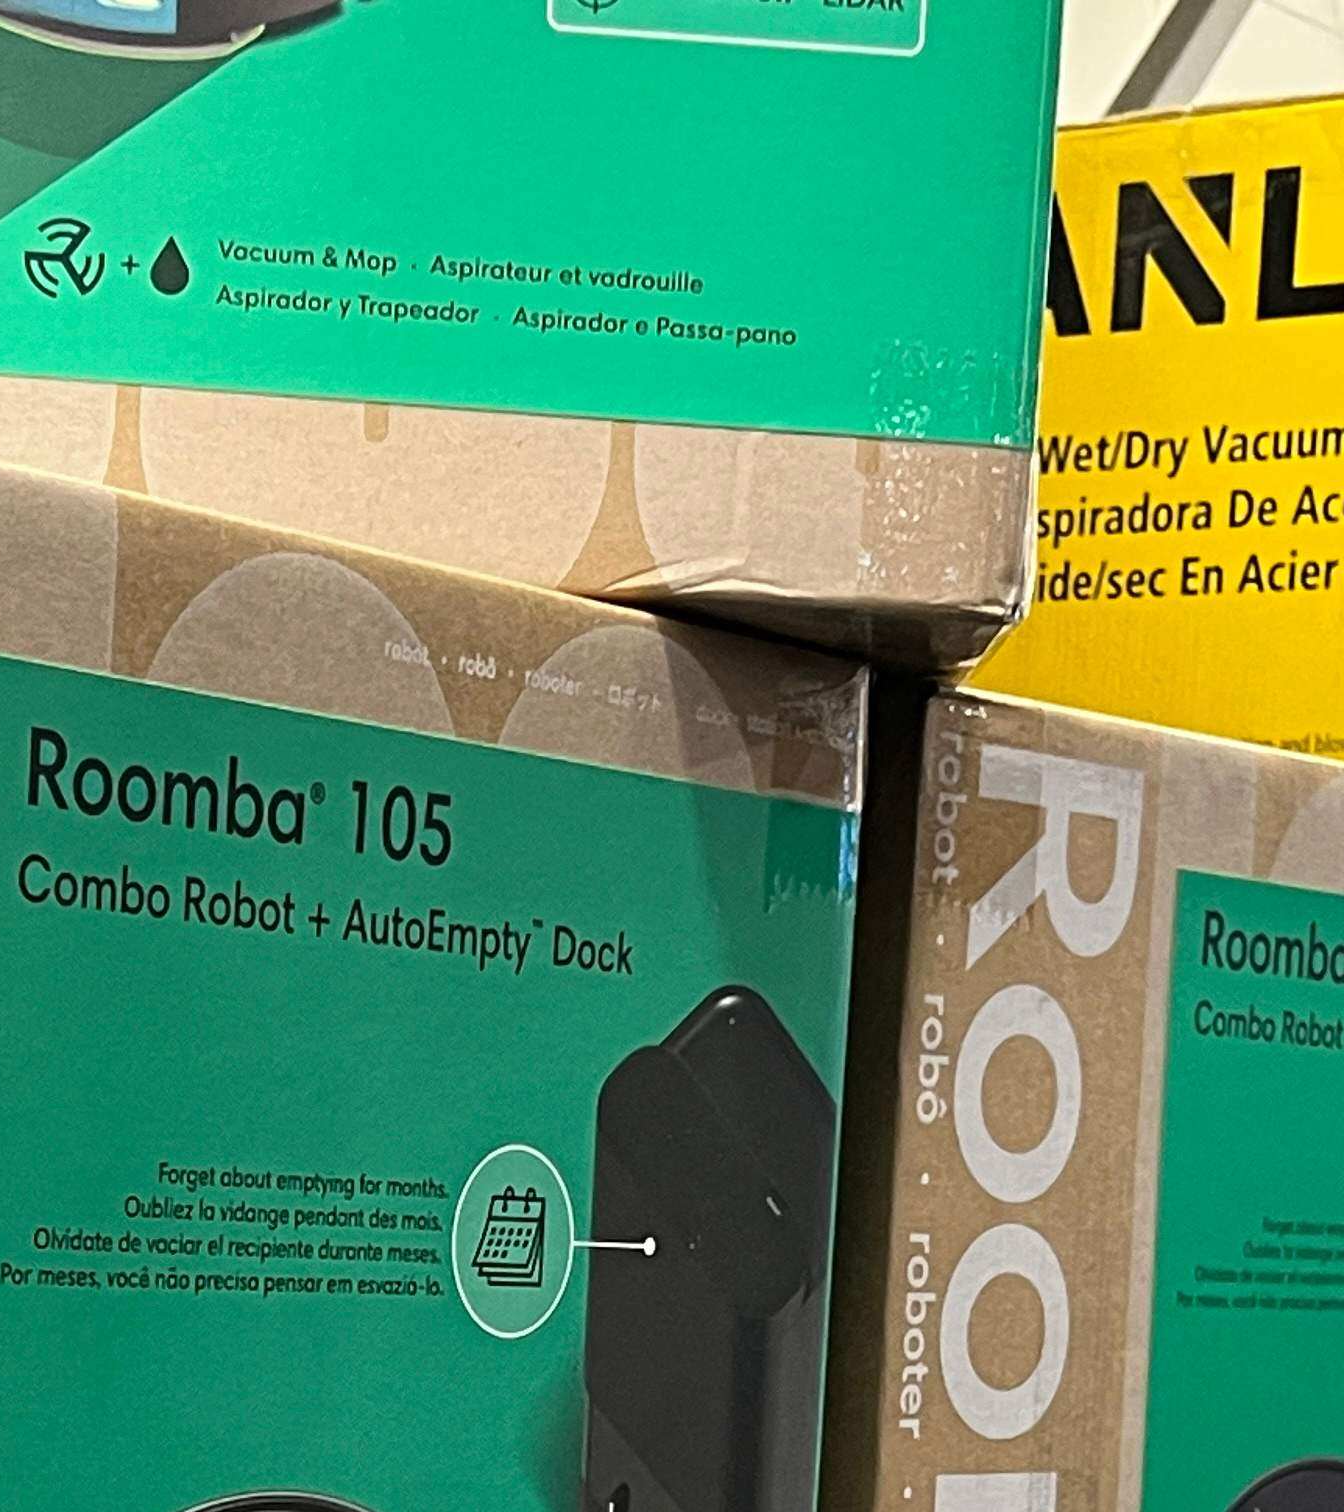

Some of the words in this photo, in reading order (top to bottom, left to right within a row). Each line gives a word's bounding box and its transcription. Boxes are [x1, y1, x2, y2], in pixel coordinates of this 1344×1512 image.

[218, 239, 315, 266] Vacuum
[322, 246, 338, 268] &
[345, 248, 397, 277] Mop
[429, 255, 552, 283] Aspirateur
[559, 266, 582, 286] et
[589, 268, 704, 295] vadrouille
[216, 284, 333, 313] Aspirador
[339, 299, 352, 320] y
[358, 294, 479, 323] Trapeador
[512, 306, 629, 334] Aspirador
[635, 319, 649, 336] e
[657, 316, 797, 348] Passa-pano
[1038, 428, 1188, 478] Wet/Dry
[1037, 489, 1213, 548] spiradora
[1229, 487, 1276, 528] De
[1037, 560, 1165, 602] ide/sec
[1181, 556, 1224, 597] En
[1238, 548, 1338, 592] Acier
[349, 780, 454, 867] 105
[17, 853, 172, 920] Combo
[183, 874, 296, 937] Robot
[552, 923, 635, 977] Dock
[1194, 1000, 1276, 1043] Combo
[1281, 1009, 1344, 1051] Robot
[916, 993, 949, 1125] robô
[159, 1162, 216, 1193] Forget
[220, 1166, 273, 1189] about
[276, 1172, 356, 1201] emptying
[359, 1172, 383, 1196] for
[386, 1176, 451, 1200] months.
[124, 1195, 194, 1221] Oubliez
[199, 1198, 216, 1222] la
[219, 1200, 291, 1232] vidange
[294, 1205, 365, 1231] pendant
[368, 1207, 398, 1230] des
[118, 1230, 143, 1254] de
[147, 1233, 204, 1256] vaciar
[207, 1234, 226, 1257] el
[228, 1236, 315, 1265] recipiente
[318, 1238, 384, 1262] durante
[0, 1261, 34, 1287] Por
[37, 1268, 103, 1290] meses,
[107, 1265, 151, 1290] você
[155, 1266, 191, 1291] não
[194, 1272, 260, 1296] precisa
[263, 1275, 325, 1298] pensar
[327, 1277, 354, 1295] em
[898, 1231, 937, 1440] roboter
